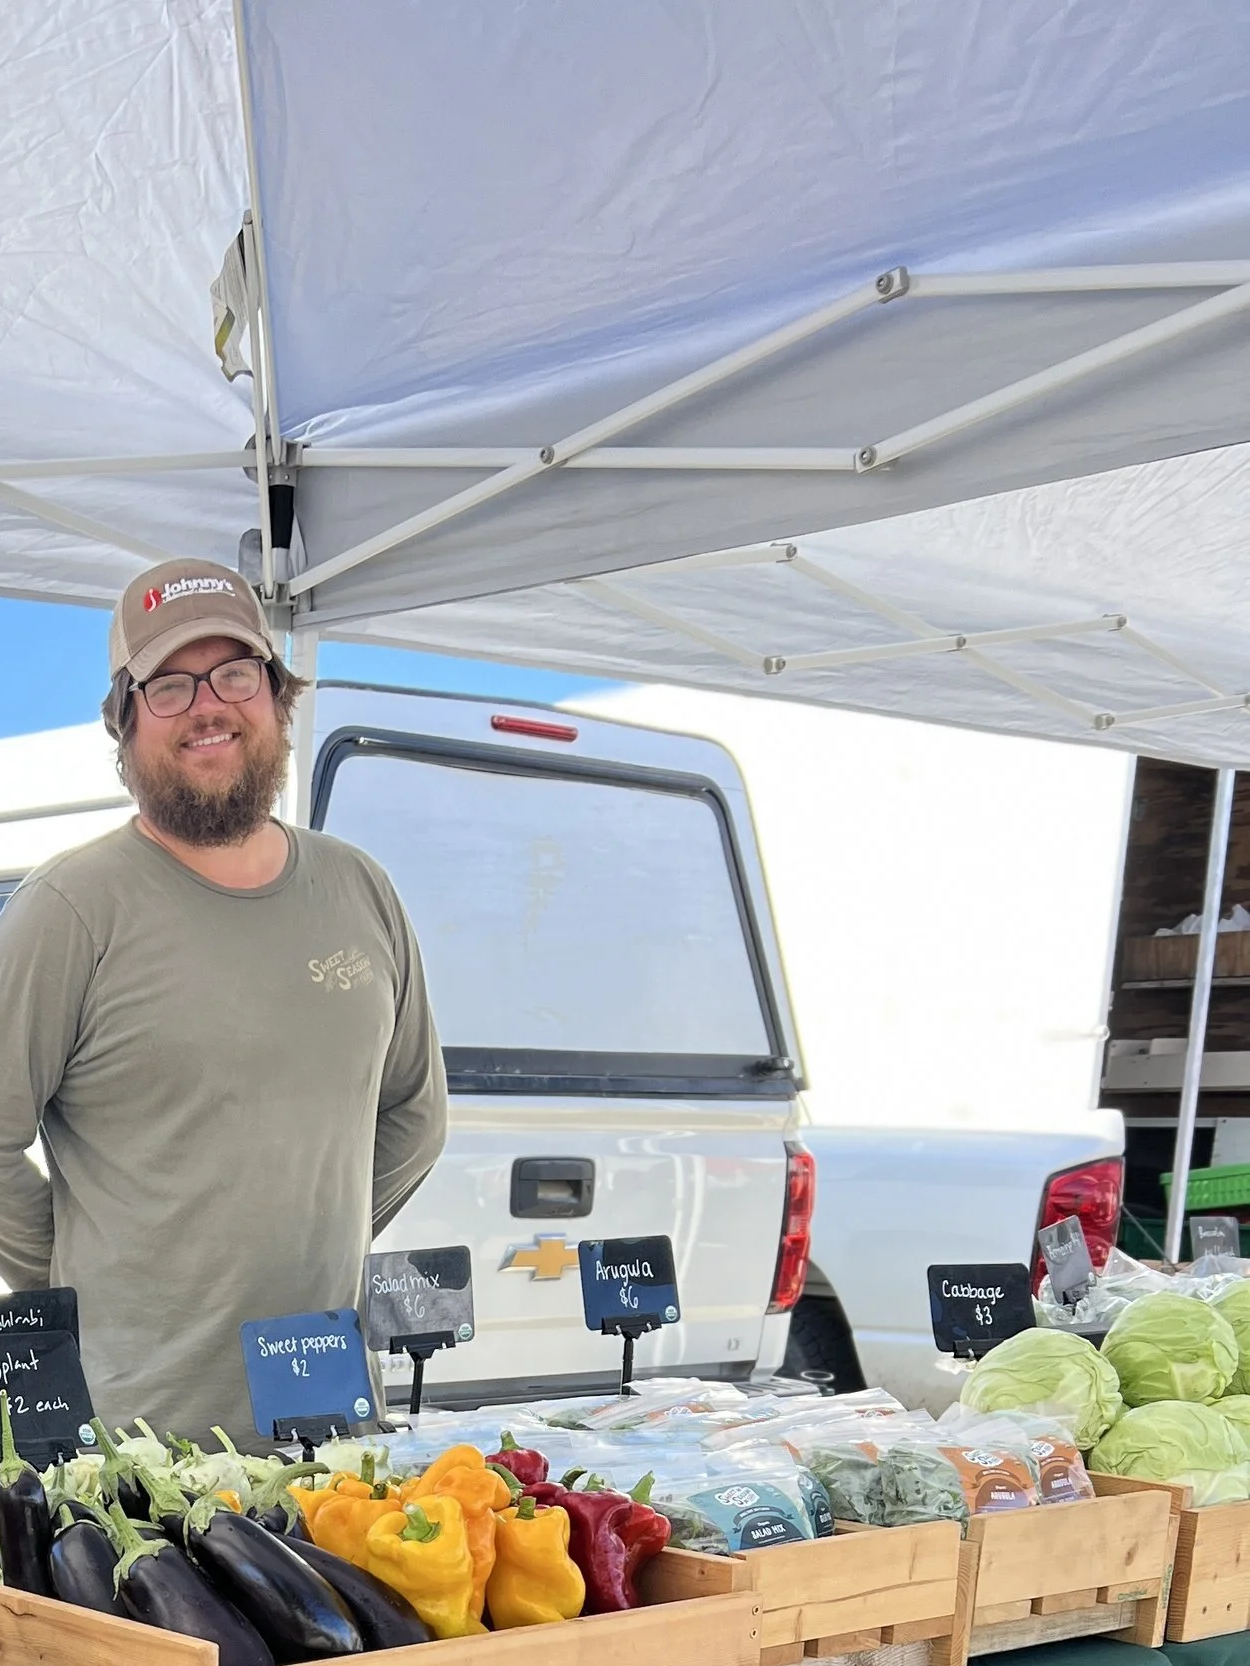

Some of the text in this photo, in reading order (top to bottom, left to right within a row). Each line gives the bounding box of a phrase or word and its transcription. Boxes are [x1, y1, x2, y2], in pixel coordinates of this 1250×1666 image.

[161, 578, 234, 599] Johnny's
[372, 1271, 440, 1294] Salad mix
[596, 1259, 654, 1287] Arugula
[619, 1285, 639, 1309] $6
[942, 1279, 1005, 1305] Cabbage
[403, 1296, 426, 1319] $6
[974, 1303, 993, 1326] $3
[257, 1334, 347, 1358] Sweet peppers
[291, 1357, 310, 1377] $2
[35, 1396, 70, 1412] each
[750, 1523, 787, 1540] SALAD MIX
